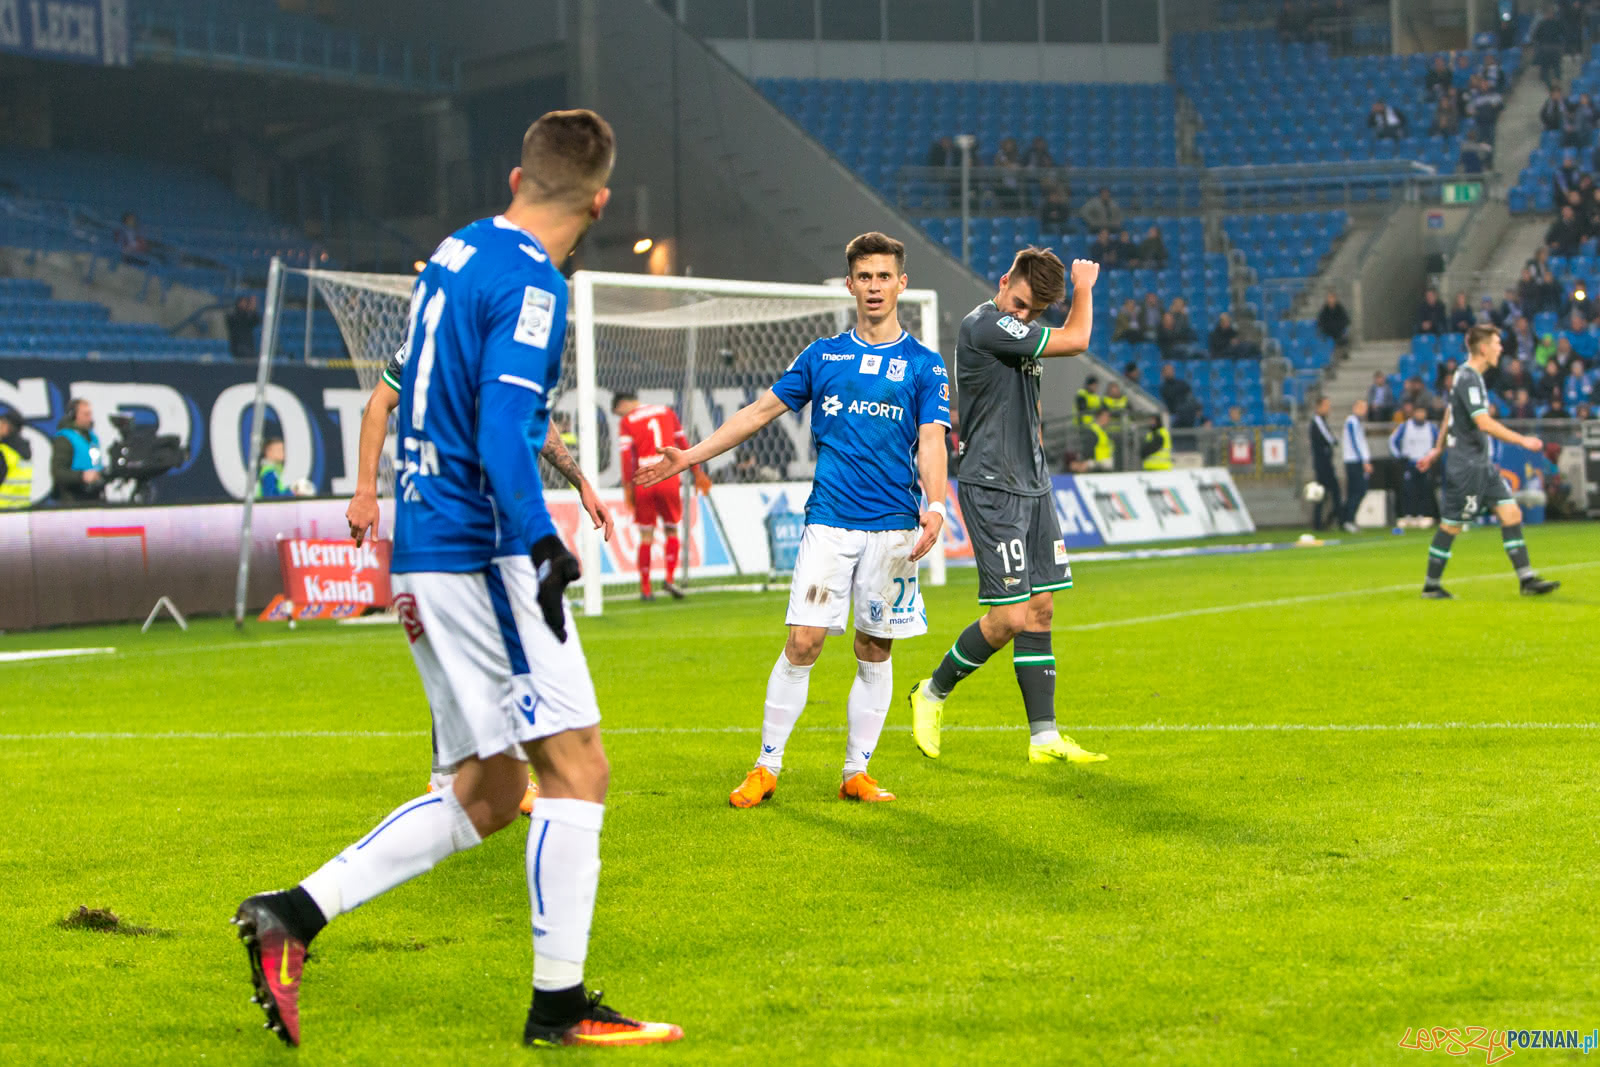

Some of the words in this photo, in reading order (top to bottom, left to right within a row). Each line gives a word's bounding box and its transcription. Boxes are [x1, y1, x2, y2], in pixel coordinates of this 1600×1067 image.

[822, 353, 855, 361] macron
[848, 400, 904, 421] AFORTI
[647, 418, 662, 449] 1
[289, 540, 380, 574] Henryk
[996, 538, 1025, 574] 19
[304, 575, 374, 604] Kania
